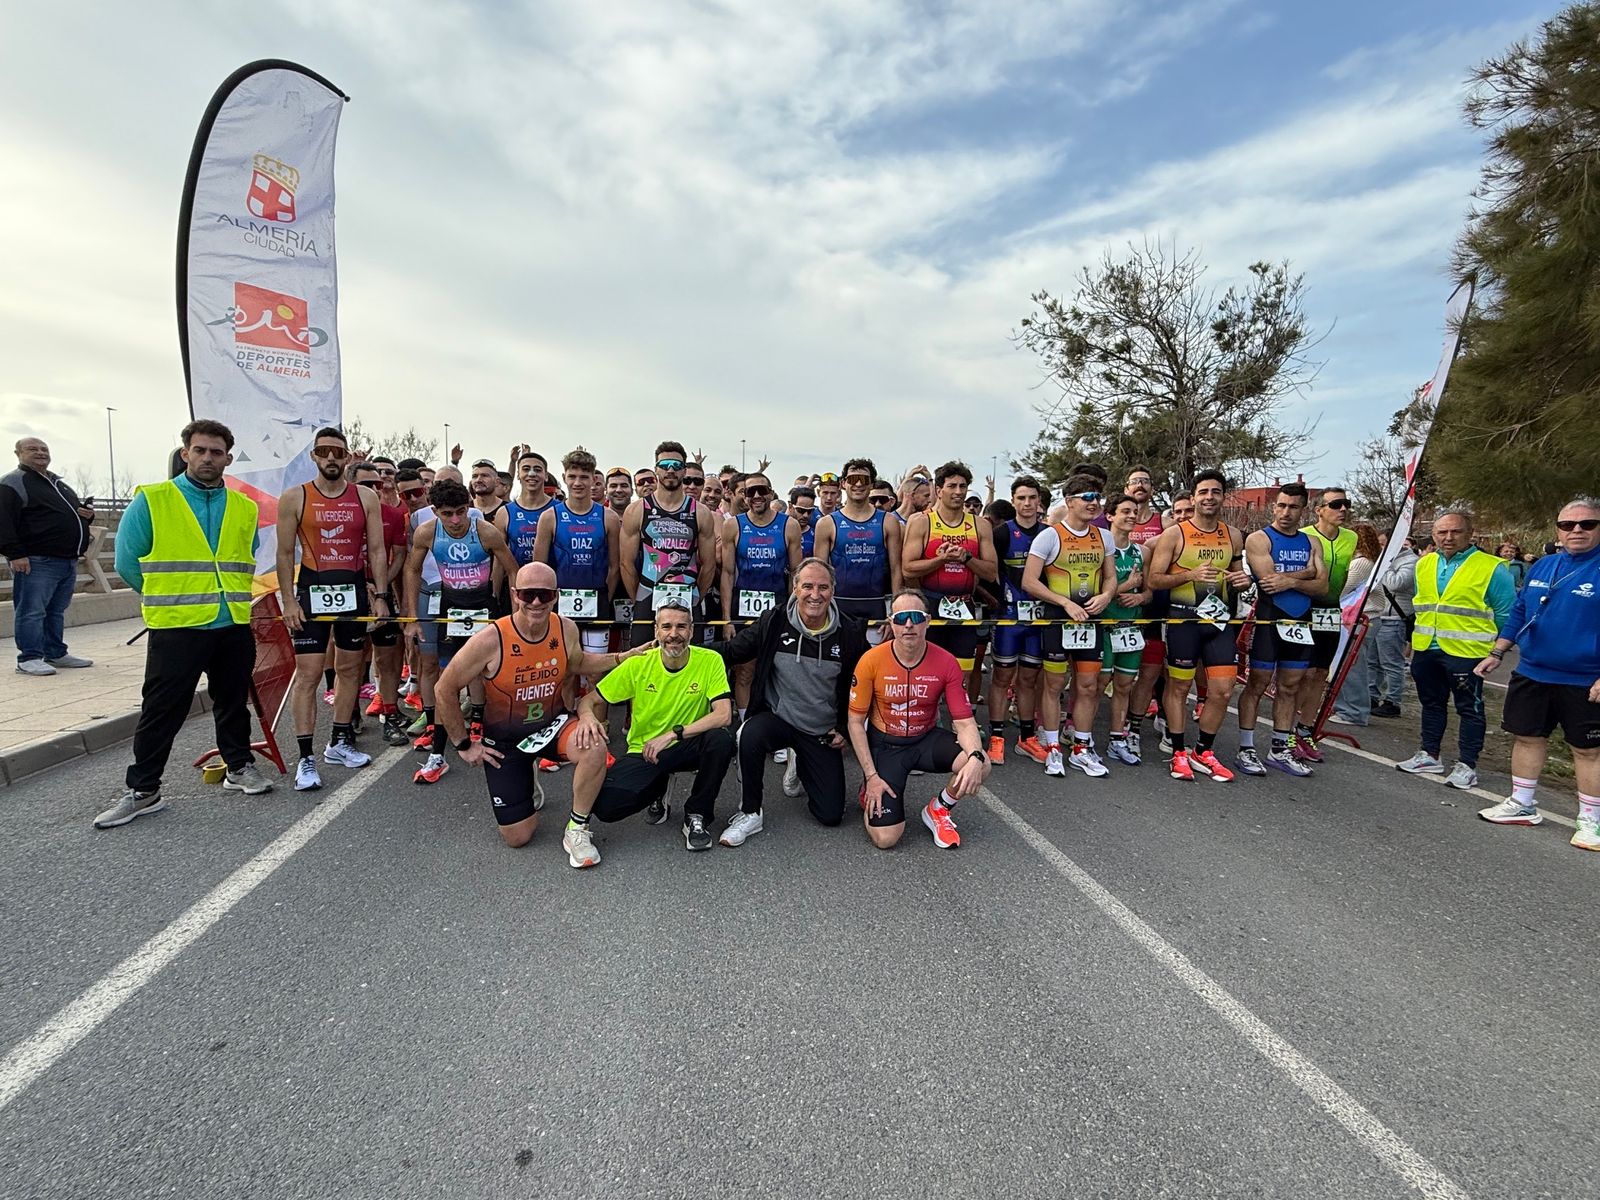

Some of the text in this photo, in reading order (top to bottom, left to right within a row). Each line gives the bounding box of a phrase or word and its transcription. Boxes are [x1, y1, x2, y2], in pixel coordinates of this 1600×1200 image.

[217, 214, 319, 257] ALMERÍA
[243, 232, 296, 258] CIUDAD
[236, 350, 311, 369] DEPORTES
[236, 361, 253, 371] DE
[571, 537, 593, 550] DIAZ
[652, 537, 689, 549] GONZALEZ
[747, 547, 777, 559] REQUENA
[1068, 552, 1100, 564] CONTRERAS
[1197, 549, 1224, 560] ARROYO
[443, 566, 482, 580] GUILLÉN
[321, 592, 346, 608] 99
[573, 597, 583, 612] 8
[744, 598, 771, 612] 101
[1027, 607, 1043, 620] 16
[1205, 604, 1224, 620] 22
[463, 616, 474, 631] 9
[1316, 614, 1335, 627] 71
[1072, 630, 1089, 644] 14
[1120, 633, 1138, 648] 15
[1285, 627, 1304, 640] 46
[514, 667, 560, 685] EL EJIDO
[515, 681, 557, 702] FUENTES
[884, 683, 929, 698] MARTINEZ
[890, 709, 925, 717] Europack
